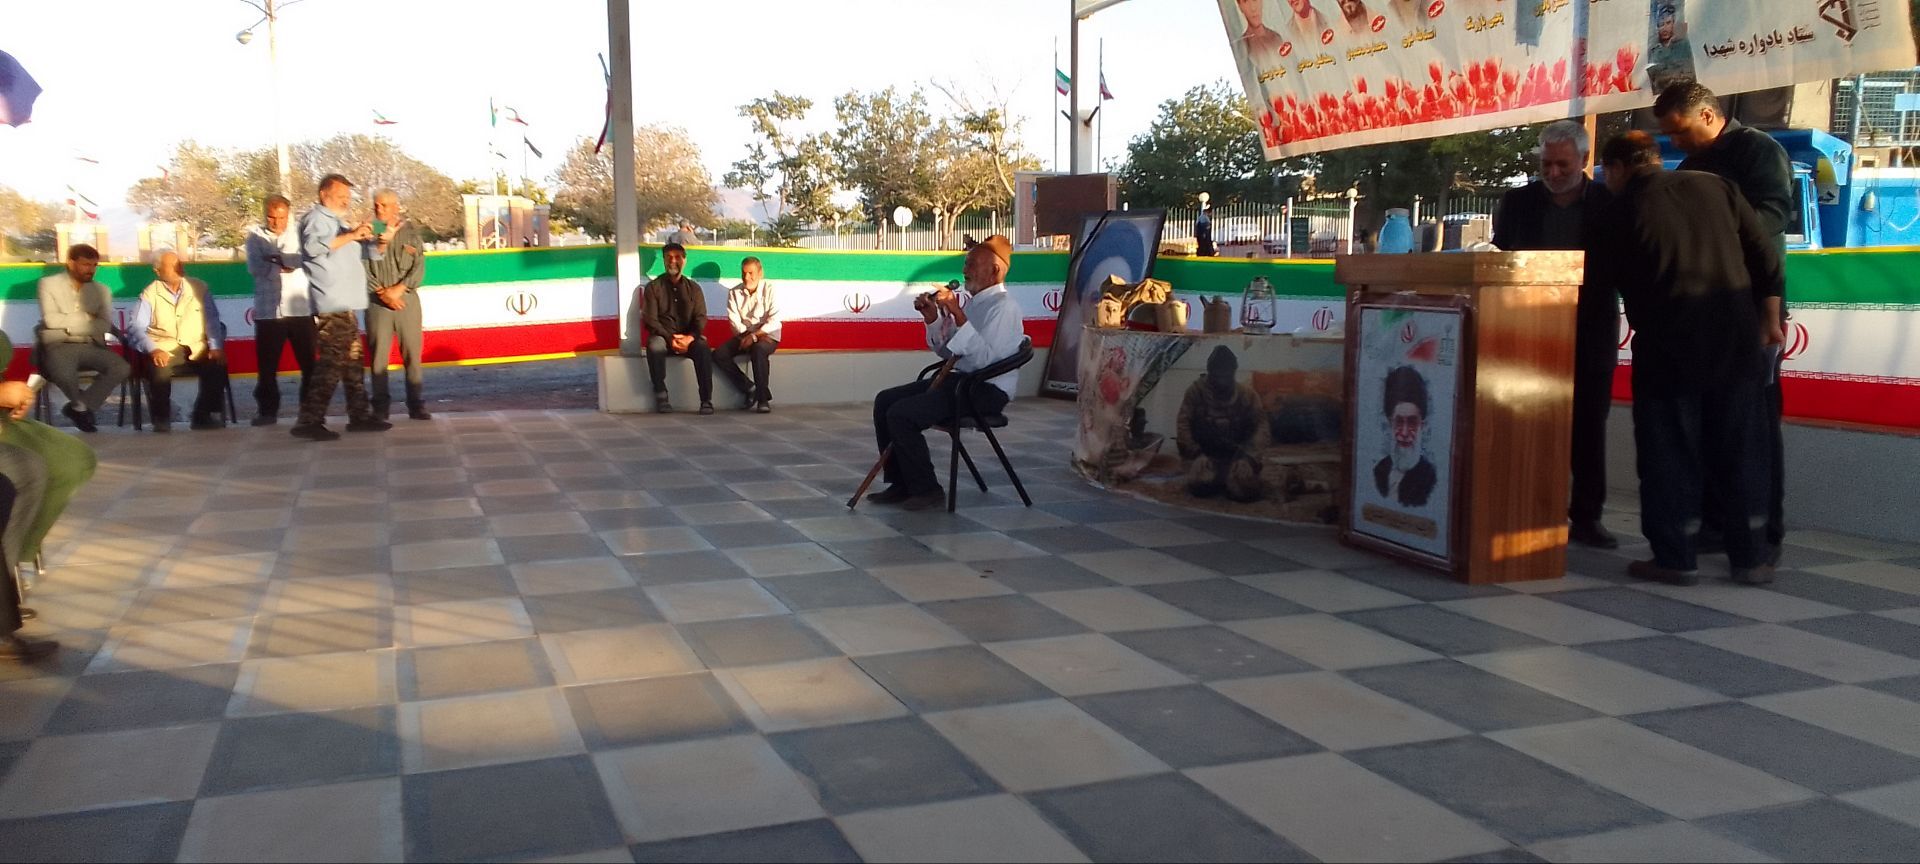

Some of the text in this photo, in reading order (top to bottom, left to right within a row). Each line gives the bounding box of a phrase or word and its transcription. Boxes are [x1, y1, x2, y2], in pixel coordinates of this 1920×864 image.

[1702, 24, 1814, 59] ستاد یادواره شهدا
